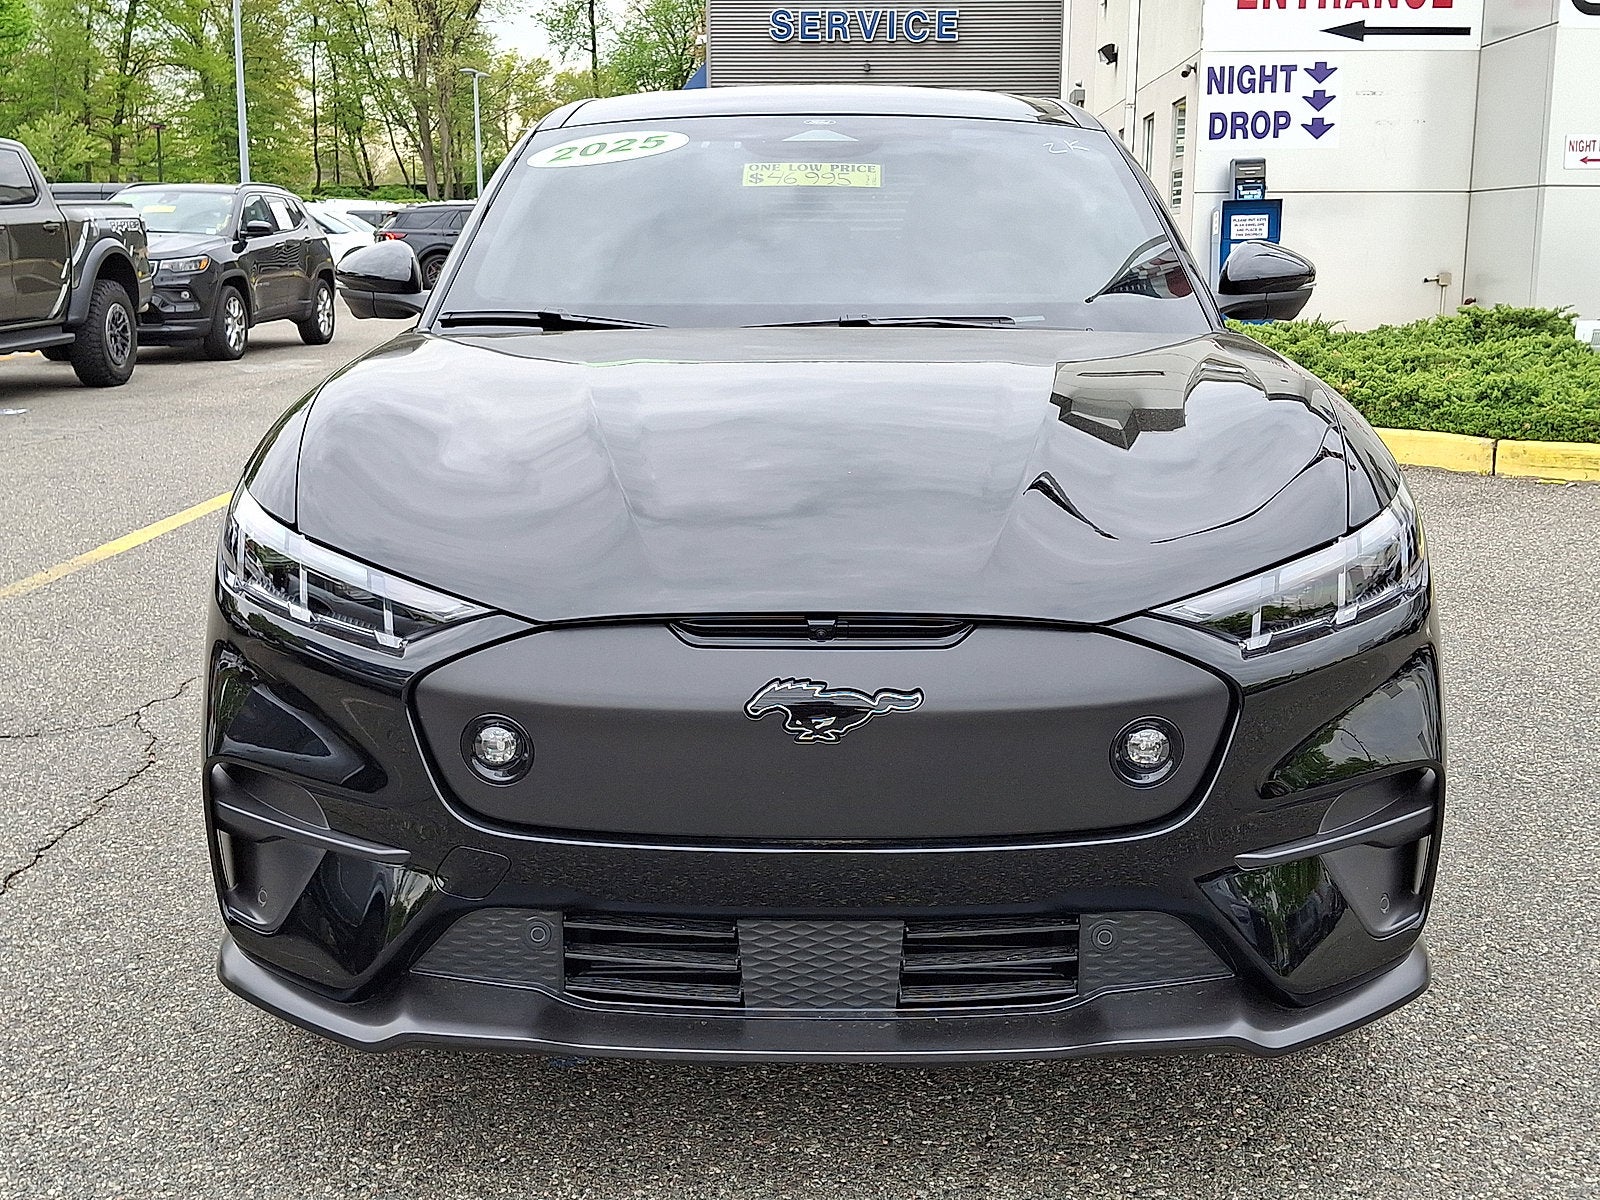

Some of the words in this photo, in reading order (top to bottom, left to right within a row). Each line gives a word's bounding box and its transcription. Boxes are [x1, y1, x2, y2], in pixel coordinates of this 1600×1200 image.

[768, 8, 960, 42] SERVICE
[1207, 64, 1298, 95] NIGHT
[1208, 110, 1291, 140] DROP
[546, 134, 669, 164] 2025
[1568, 139, 1597, 152] NIGHT
[748, 164, 781, 172] ONE
[788, 164, 822, 172] LOW
[830, 164, 877, 173] PRICE
